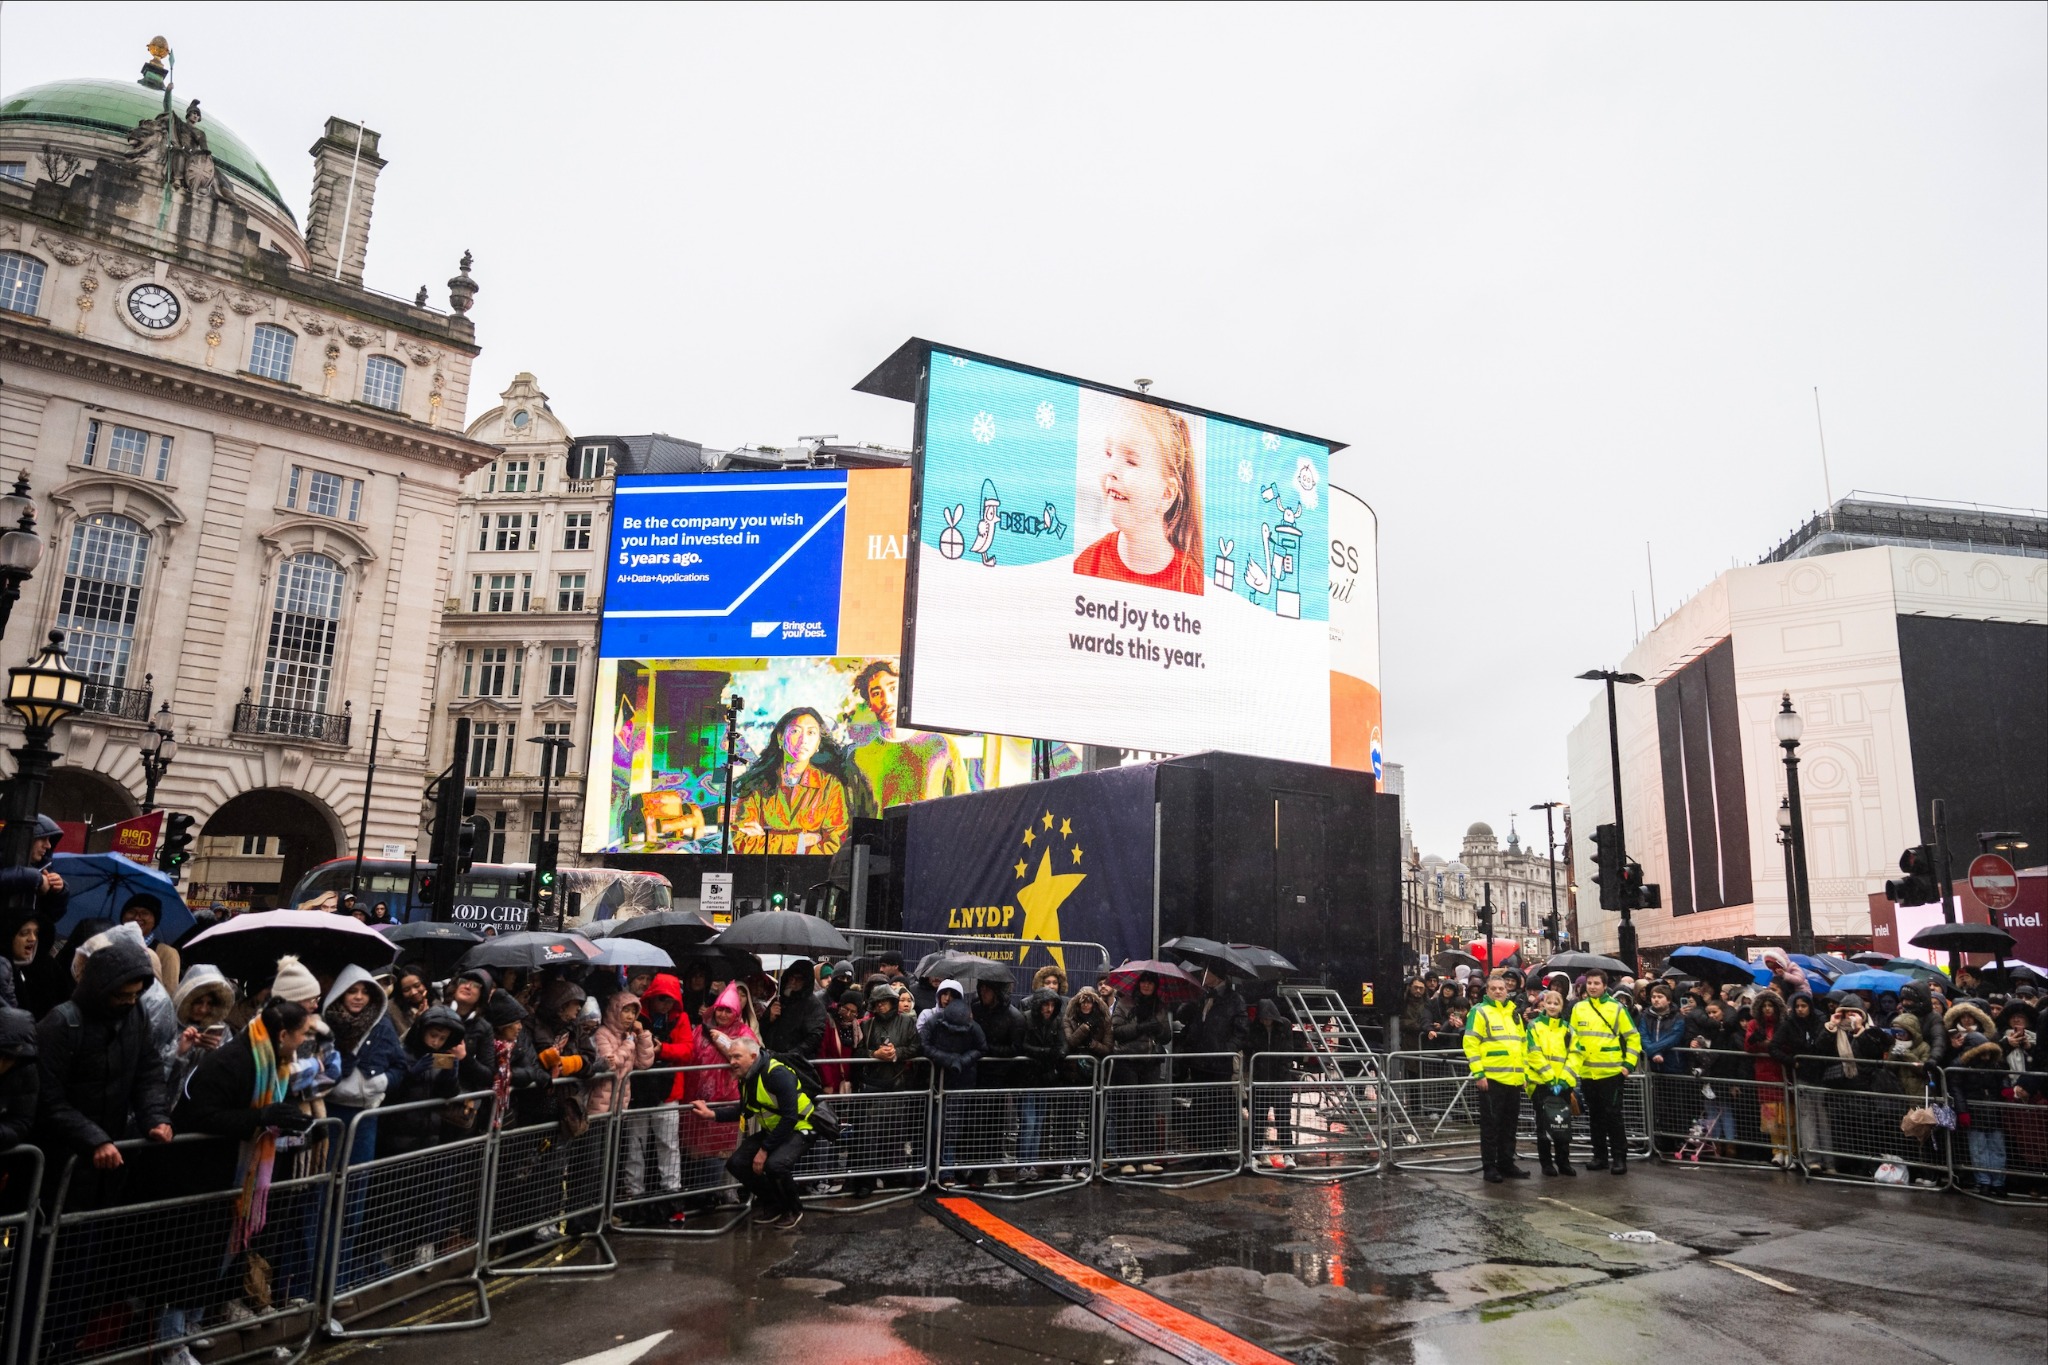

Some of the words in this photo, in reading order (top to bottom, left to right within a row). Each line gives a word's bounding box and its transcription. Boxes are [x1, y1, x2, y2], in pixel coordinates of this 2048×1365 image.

[623, 517, 642, 529] Be
[645, 516, 669, 528] the
[671, 516, 738, 531] company
[740, 516, 767, 530] you
[770, 512, 804, 526] wish
[621, 537, 648, 550] you
[651, 533, 679, 546] had
[681, 531, 743, 545] invested
[746, 531, 760, 544] in
[619, 552, 629, 564] 5
[630, 553, 671, 568] years
[672, 552, 703, 567] ago.
[1328, 539, 1359, 575] SS
[617, 573, 710, 584] AI+Data+Applications
[1075, 595, 1119, 622] Send
[1120, 601, 1149, 632] joy
[1151, 609, 1170, 630] to
[1173, 611, 1202, 635] the
[782, 621, 806, 632] Bring
[806, 621, 822, 630] out
[782, 629, 804, 640] your
[804, 629, 827, 638] best.
[1069, 633, 1124, 656] wards
[1127, 637, 1160, 662] this
[1163, 648, 1206, 669] year.
[119, 837, 138, 845] BUS
[122, 829, 140, 838] BIG
[452, 904, 488, 920] OOD
[948, 906, 1014, 928] LNYDP
[505, 923, 521, 931] BAD
[1874, 923, 1889, 937] intel
[987, 951, 1014, 960] PARADE
